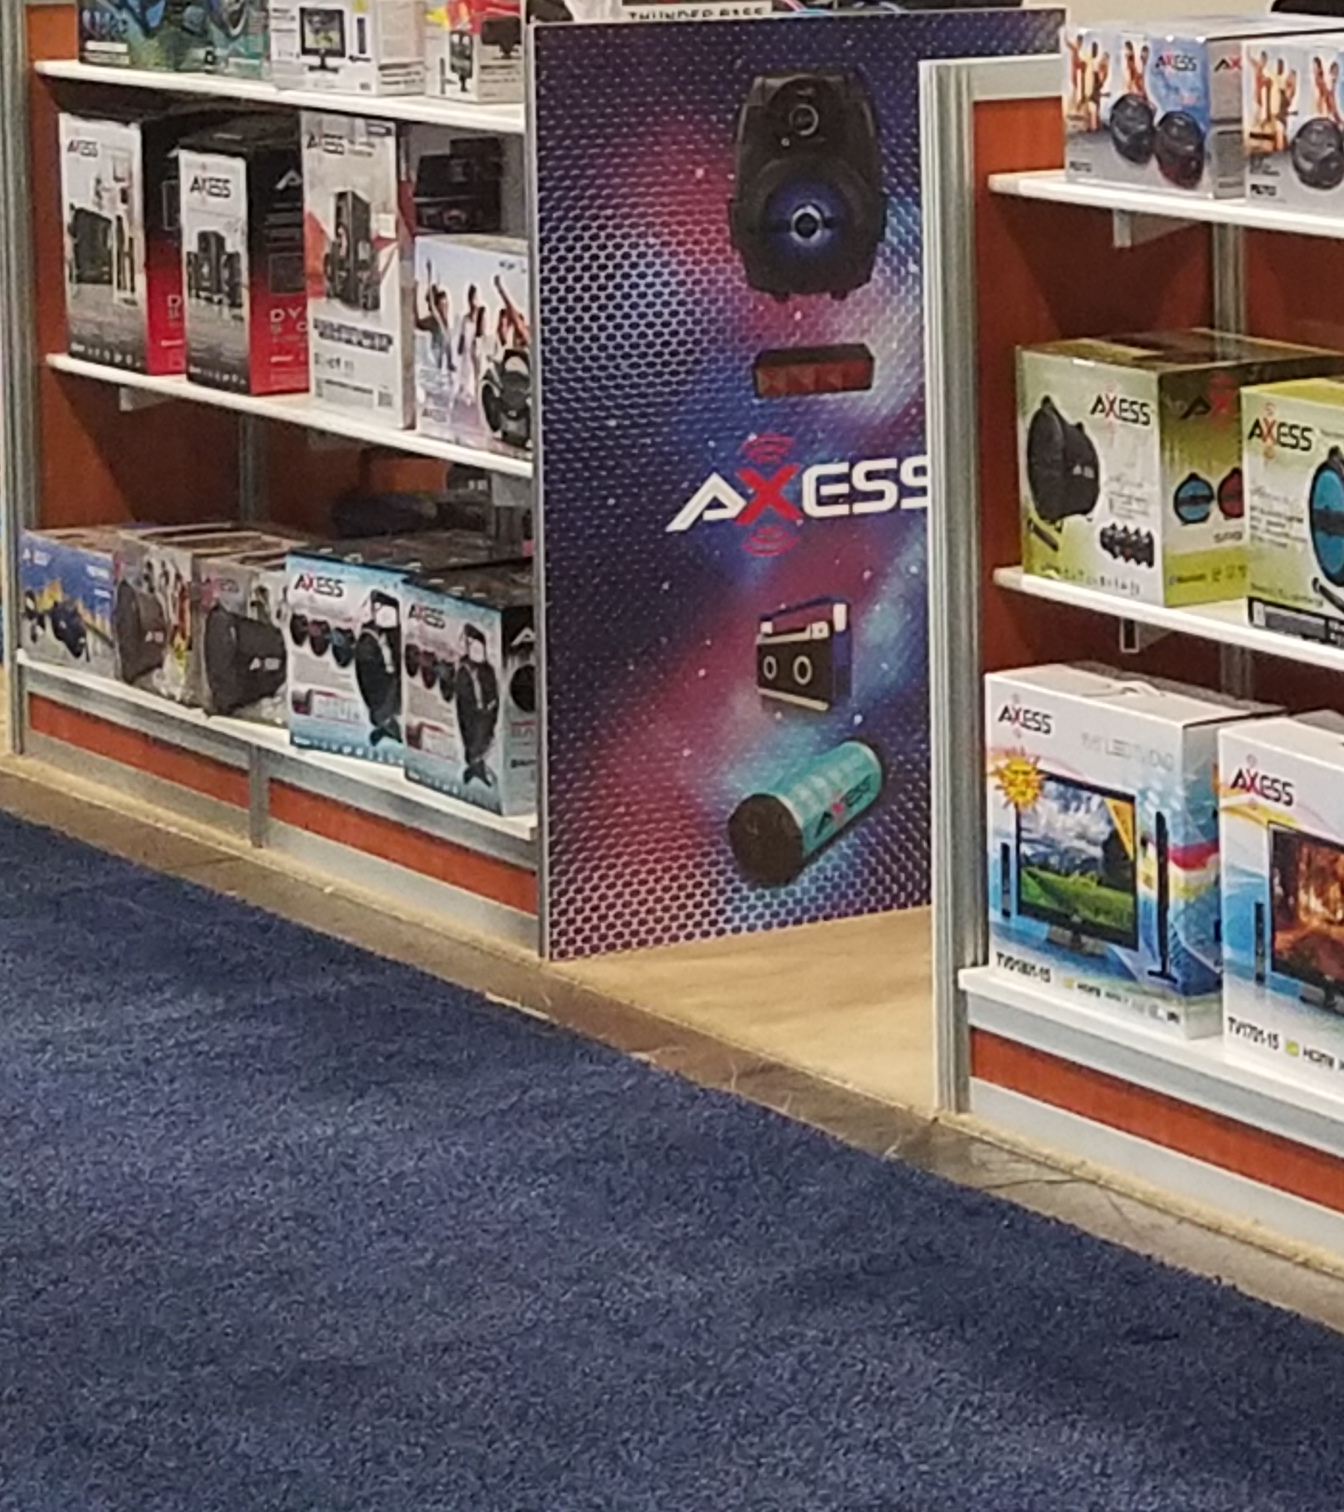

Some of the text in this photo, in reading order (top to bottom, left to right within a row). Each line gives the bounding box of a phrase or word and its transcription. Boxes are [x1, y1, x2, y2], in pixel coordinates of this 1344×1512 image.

[1089, 393, 1151, 426] AXESS
[1248, 417, 1313, 451] AXESS
[666, 455, 928, 533] AXESS
[294, 574, 344, 598] AXESS
[998, 702, 1053, 736] AXESS
[1229, 768, 1295, 807] AXESS
